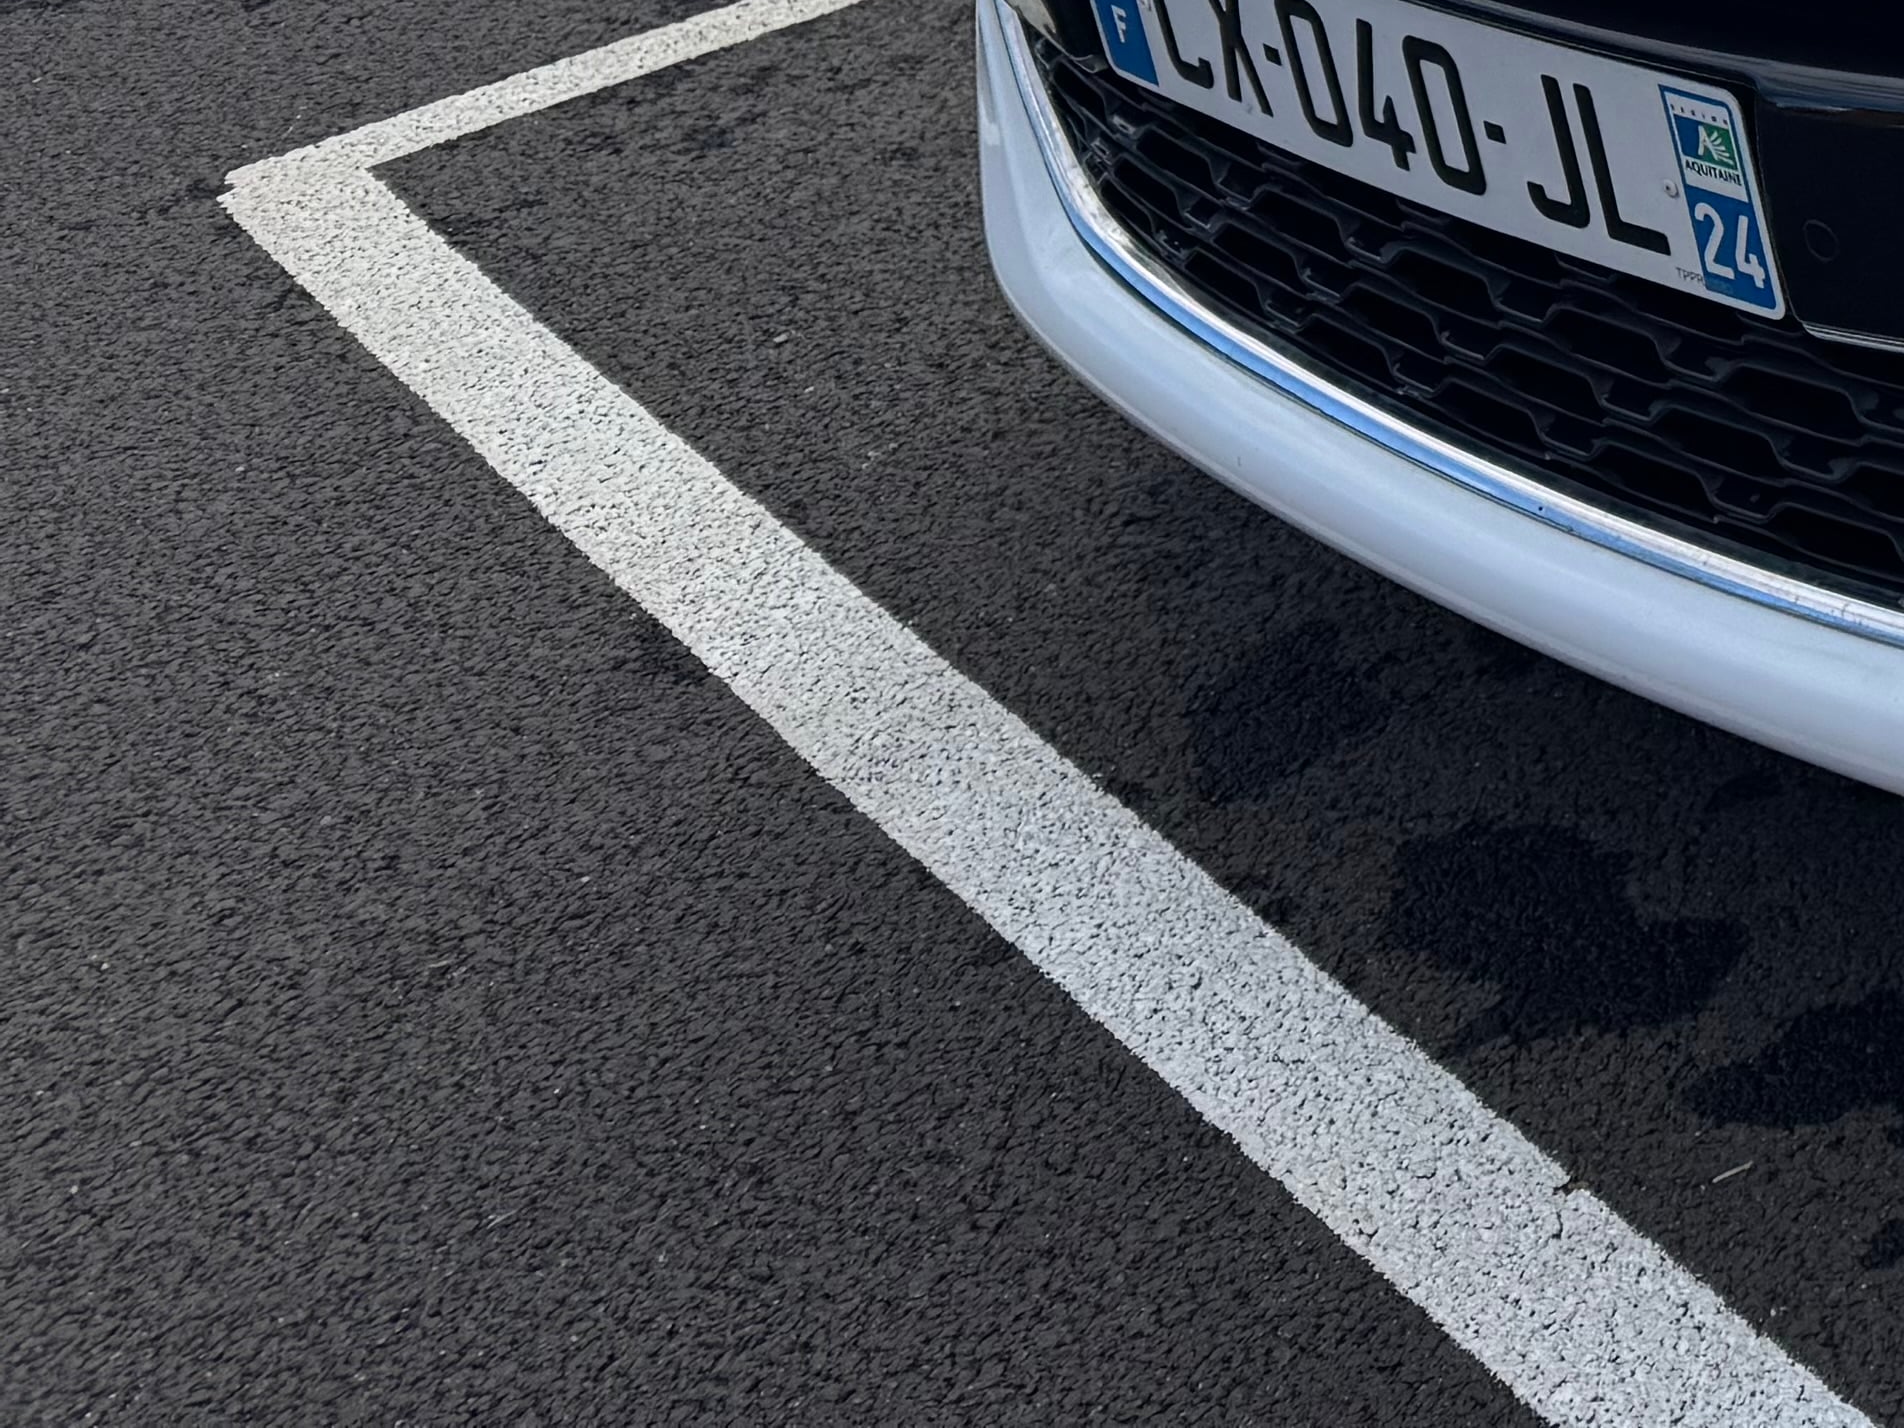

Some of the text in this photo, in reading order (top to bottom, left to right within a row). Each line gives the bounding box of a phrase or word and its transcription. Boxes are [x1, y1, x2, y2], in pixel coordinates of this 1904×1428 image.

[1111, 5, 1127, 44] F
[1684, 158, 1743, 187] AQUITAINE
[1694, 201, 1766, 289] 24
